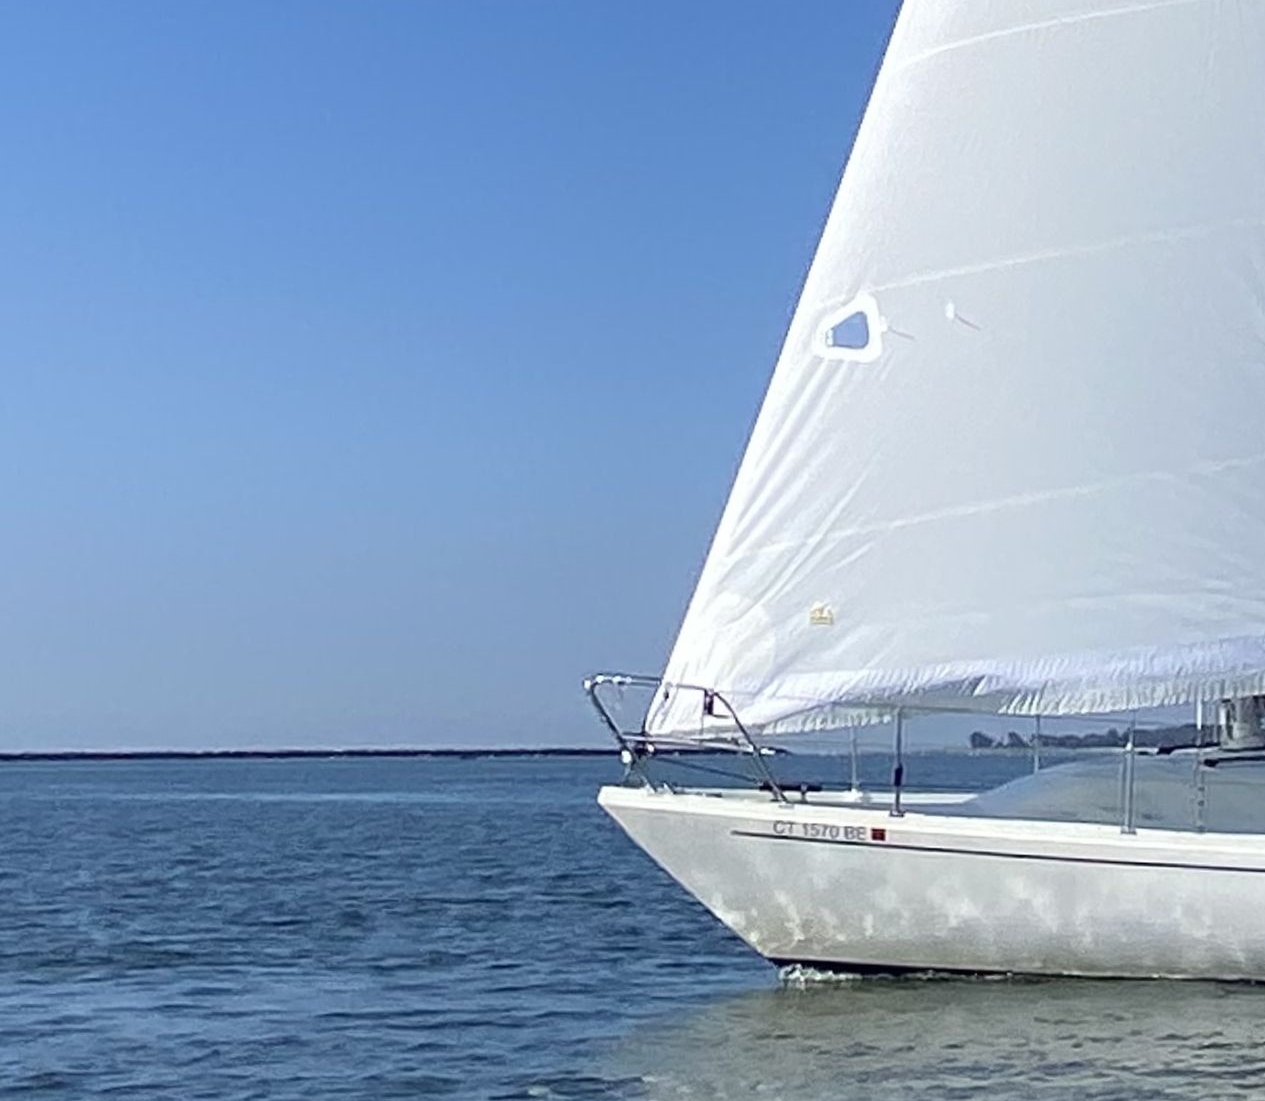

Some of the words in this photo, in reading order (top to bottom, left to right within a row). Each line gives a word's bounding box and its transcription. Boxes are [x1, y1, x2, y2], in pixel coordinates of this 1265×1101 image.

[772, 820, 795, 835] CT
[802, 823, 840, 839] 1570
[843, 826, 867, 841] BE
